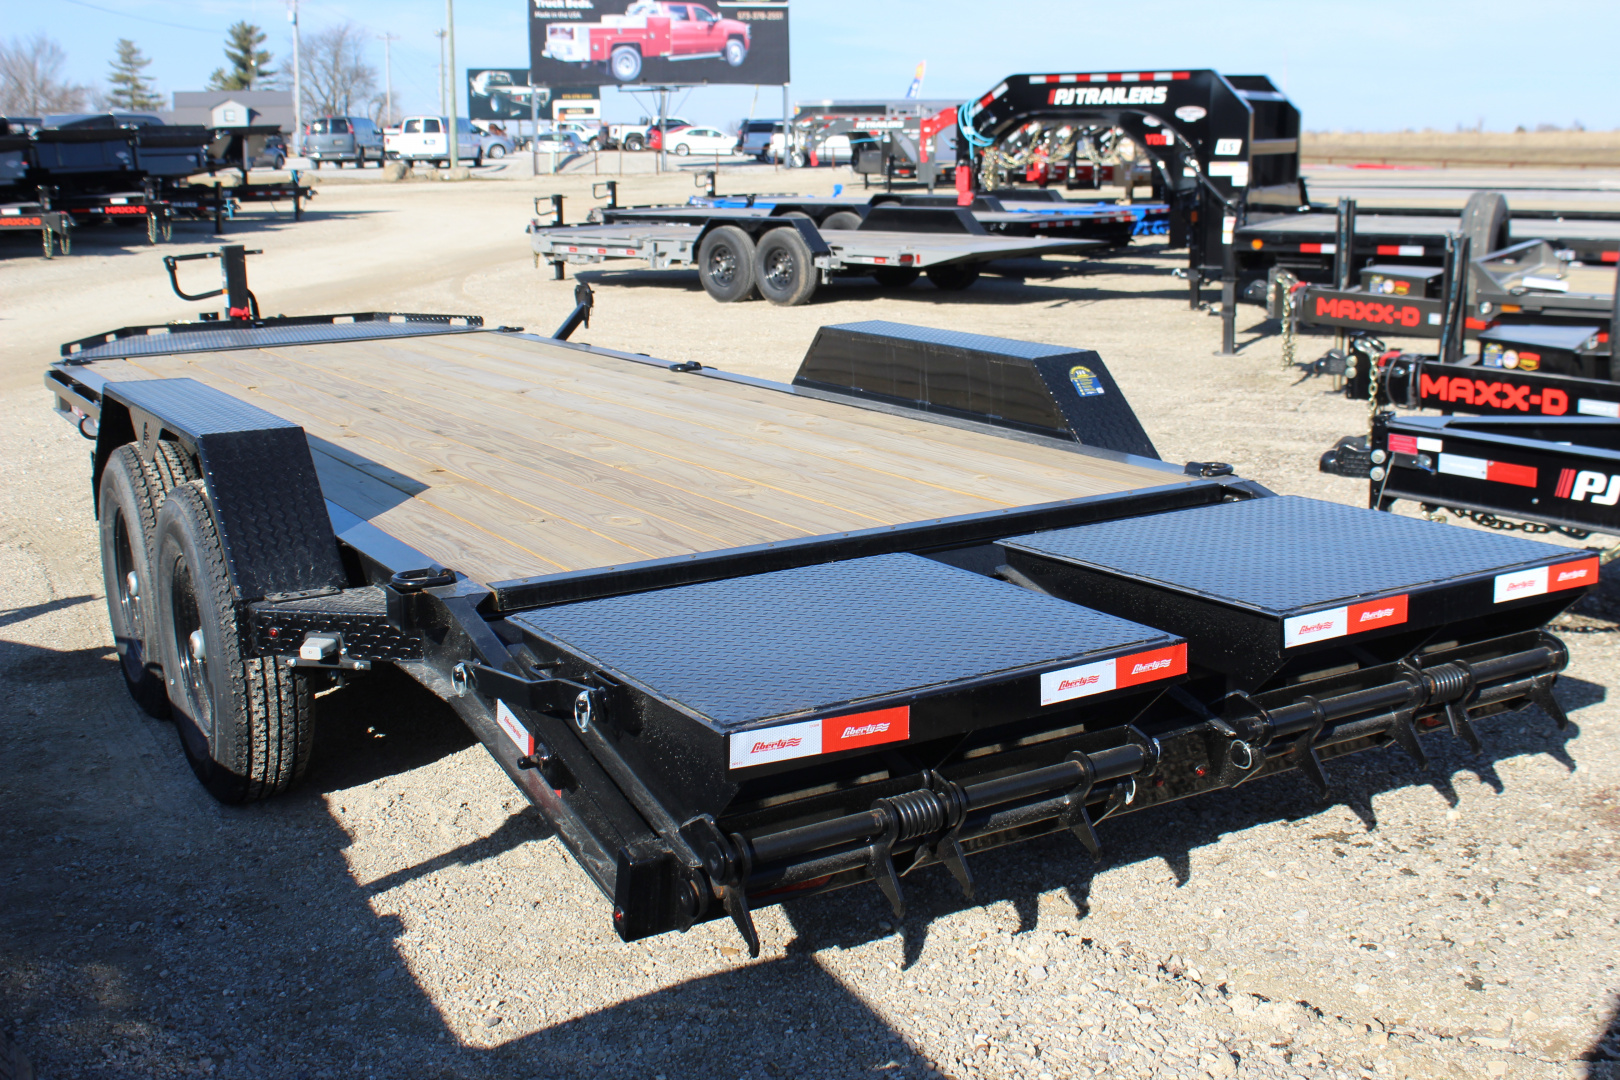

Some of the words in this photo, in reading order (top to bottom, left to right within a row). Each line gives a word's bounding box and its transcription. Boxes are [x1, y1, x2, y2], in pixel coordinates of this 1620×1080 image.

[105, 205, 146, 215] MAXX-D
[1315, 297, 1420, 328] MAXX-D
[1420, 374, 1569, 416] MAXX-D
[1570, 470, 1620, 506] PJ
[1360, 609, 1385, 623] Liberty
[1298, 622, 1324, 635] Liberty
[1131, 660, 1160, 675] Liberty
[1057, 676, 1088, 692] Liberty
[841, 723, 876, 739] Liberty
[750, 738, 788, 754] Liberty
